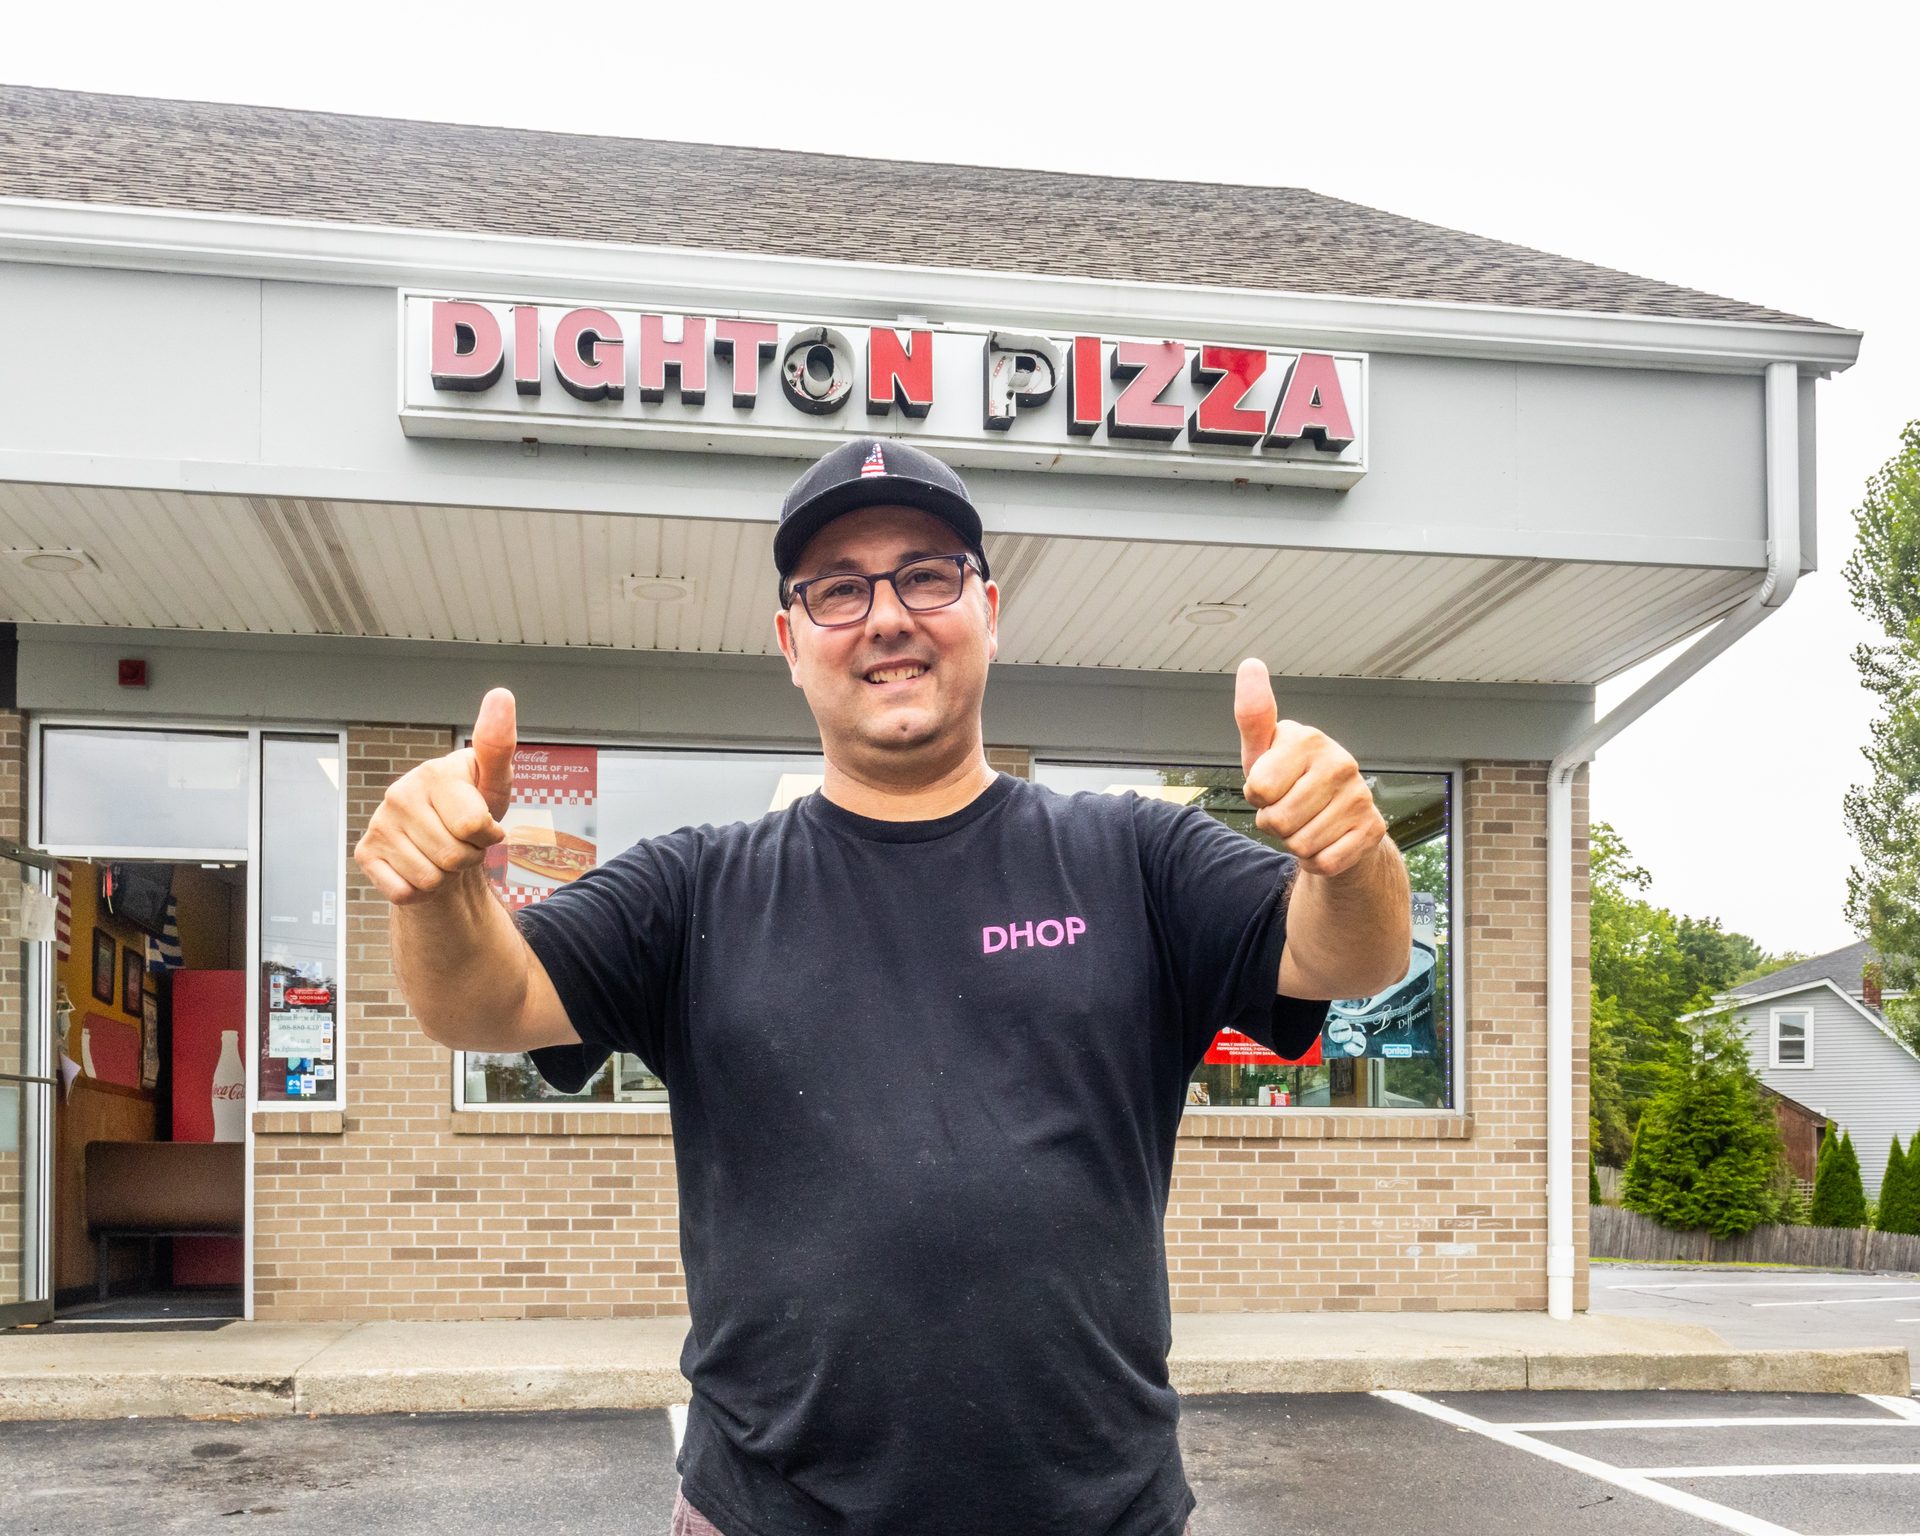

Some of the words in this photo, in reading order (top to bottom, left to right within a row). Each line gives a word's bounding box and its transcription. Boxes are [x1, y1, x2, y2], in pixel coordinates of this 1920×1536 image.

[431, 300, 934, 418] DIGHTON
[983, 330, 1354, 452] PIZZA
[517, 764, 548, 772] HOUSE
[982, 916, 1086, 953] DHOP
